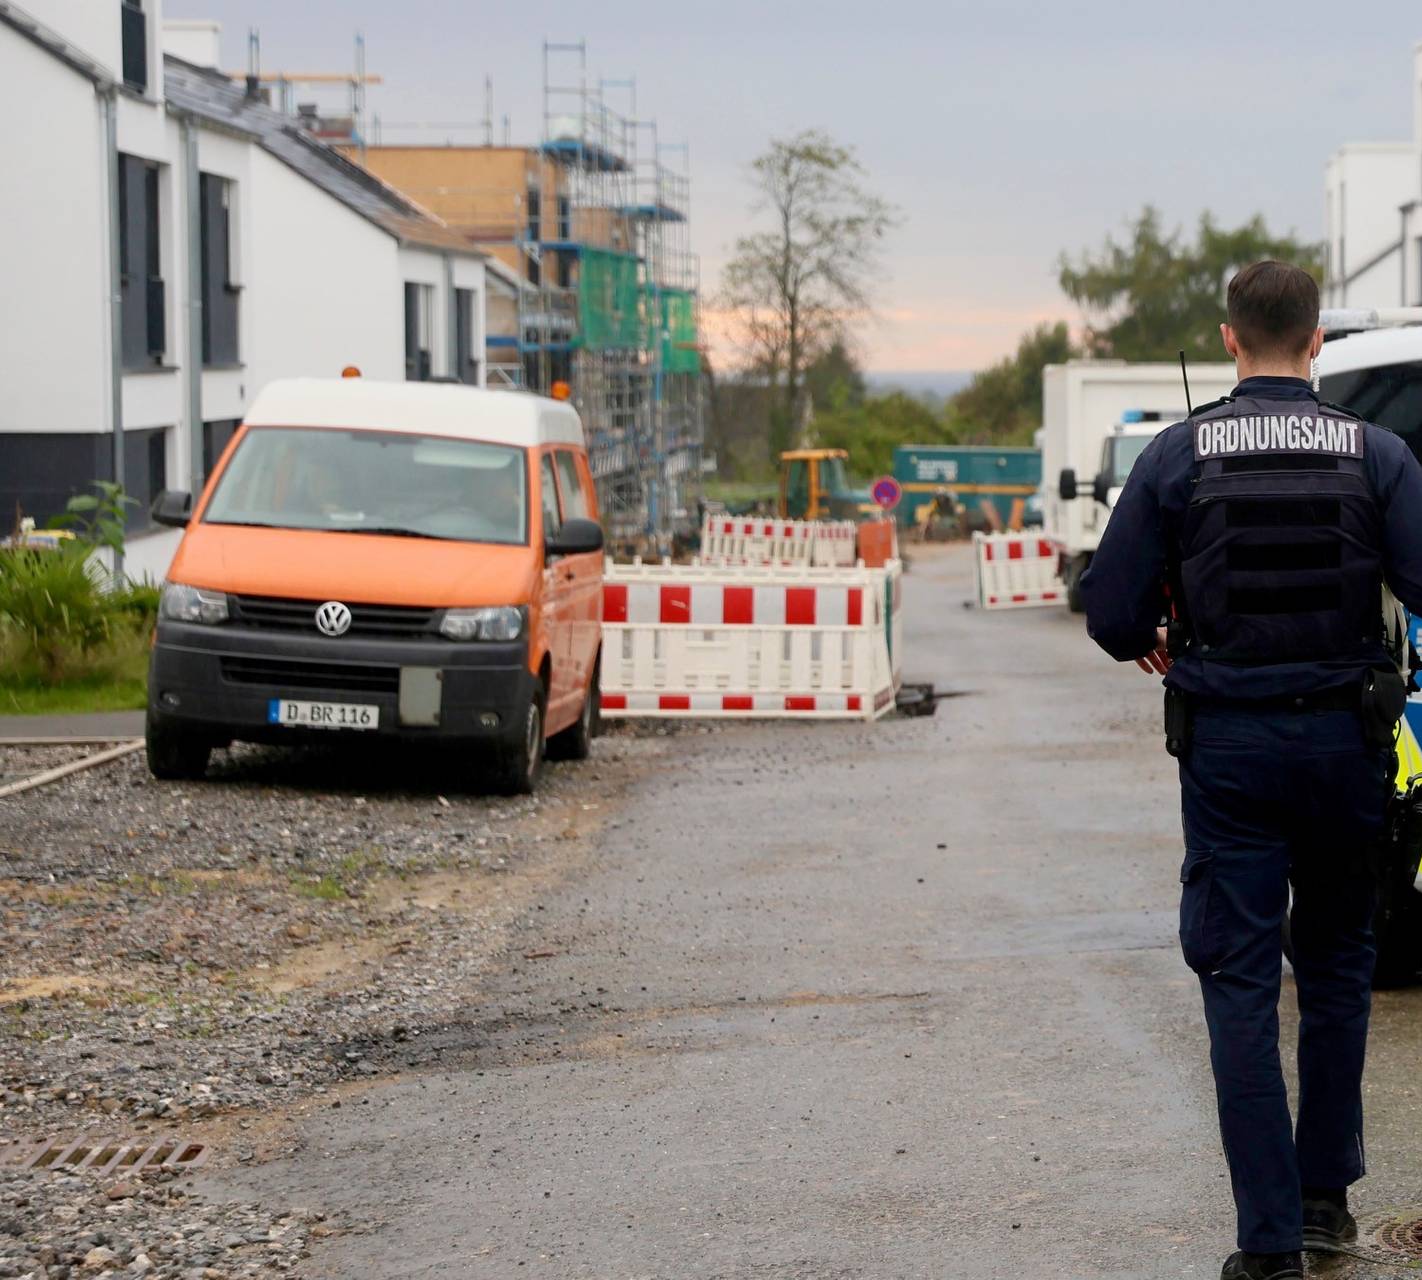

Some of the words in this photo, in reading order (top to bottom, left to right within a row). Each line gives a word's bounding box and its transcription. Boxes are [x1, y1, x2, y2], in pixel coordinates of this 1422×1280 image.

[1198, 415, 1358, 456] ORDNUNGSAMT
[286, 703, 299, 721] D
[311, 704, 334, 722] BR
[338, 707, 371, 725] 116
